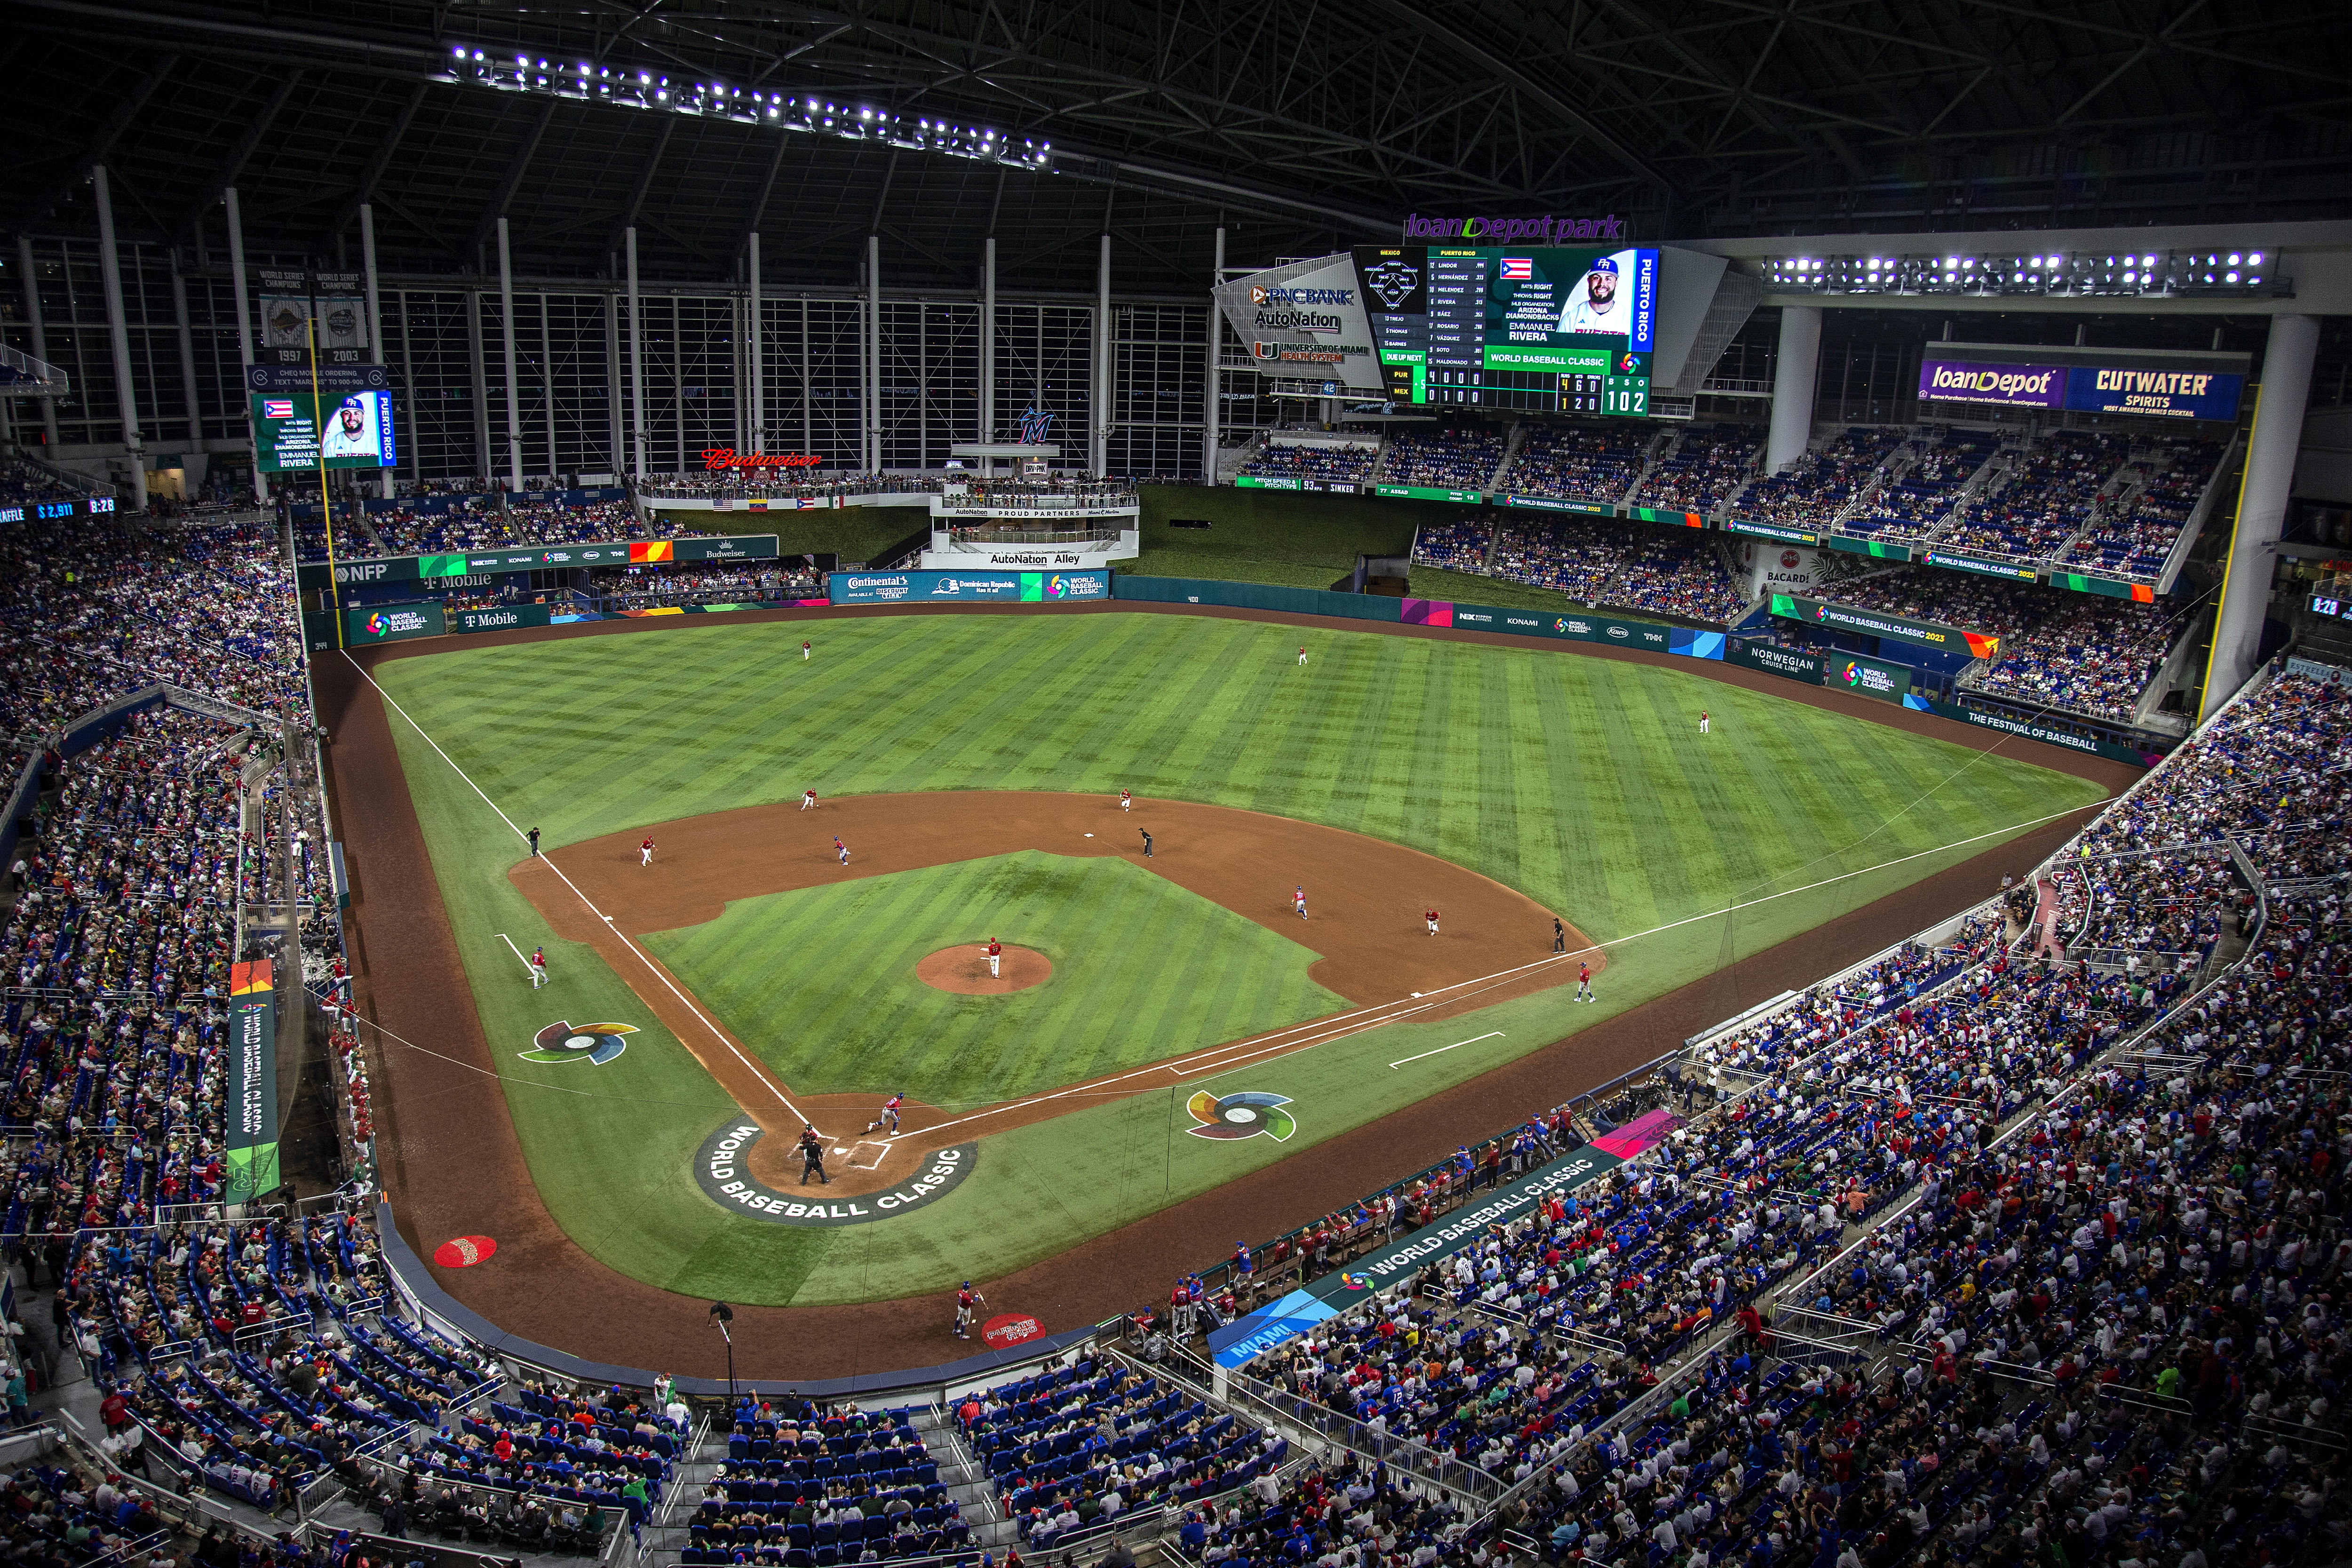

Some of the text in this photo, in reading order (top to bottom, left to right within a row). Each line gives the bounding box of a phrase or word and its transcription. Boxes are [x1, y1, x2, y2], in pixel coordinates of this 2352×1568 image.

[1406, 213, 1622, 244] loanDepot park
[260, 271, 282, 279] WORLD
[265, 280, 301, 288] CHAMPIONS
[1637, 259, 1652, 342] PUERTO RICO
[1255, 310, 1340, 327] AutoNation
[1509, 322, 1555, 331] EMMANUEL
[1509, 332, 1547, 341] RIVERA
[278, 350, 301, 361] 1997
[1281, 343, 1367, 354] UNIVERSITY OF MIAMI
[334, 350, 359, 362] 2003
[1281, 352, 1342, 362] HEALTH SYSTEM
[1491, 354, 1604, 366] WORLD BASEBALL CLASSIC
[1324, 383, 1334, 392] 42
[1932, 366, 2051, 397] loanDepot
[2096, 370, 2208, 395] CUTWATER
[2125, 395, 2170, 408] SPIRITS
[380, 398, 393, 460] PUERTO RICO
[702, 448, 821, 470] Budweiser
[1304, 480, 1314, 490] 93
[1330, 484, 1354, 493] SINKER
[38, 503, 73, 519] $ 2,911
[90, 498, 115, 513] 8:28
[1755, 527, 1780, 536] BASEBALL
[1780, 531, 1802, 540] CLASSIC
[991, 554, 1080, 565] AutoNation Alley
[1935, 556, 1958, 565] WORLD
[1958, 560, 1990, 571] BASEBALL
[1990, 566, 2018, 575] CLASSIC
[350, 564, 385, 581] NFP
[1767, 572, 1810, 583] BACARDÍ
[424, 573, 491, 589] T Mobile
[848, 576, 899, 589] Continental
[391, 617, 428, 626] BASEBALL
[466, 613, 517, 628] T Mobile
[1507, 618, 1538, 626] KONAMI
[1829, 612, 1945, 643] WORLD BASEBALL CLASSIC 2023
[1644, 633, 1663, 642] THK
[1751, 647, 1814, 670] NORWEGIAN
[1761, 659, 1799, 673] CRUISE LINE
[1863, 668, 1886, 678] WORLD
[1863, 674, 1895, 687] BASEBALL
[1969, 712, 2098, 752] THE FESTIVAL OF BASEBALL
[710, 1126, 961, 1218] WORLD BASEBALL CLASSIC
[1368, 1159, 1593, 1275] WORLD BASEBALL CLASSIC
[450, 1238, 478, 1265] MEXICO
[987, 1319, 1035, 1340] PUERTO
[1007, 1325, 1038, 1341] RICO
[1230, 1323, 1294, 1359] MIAMI
